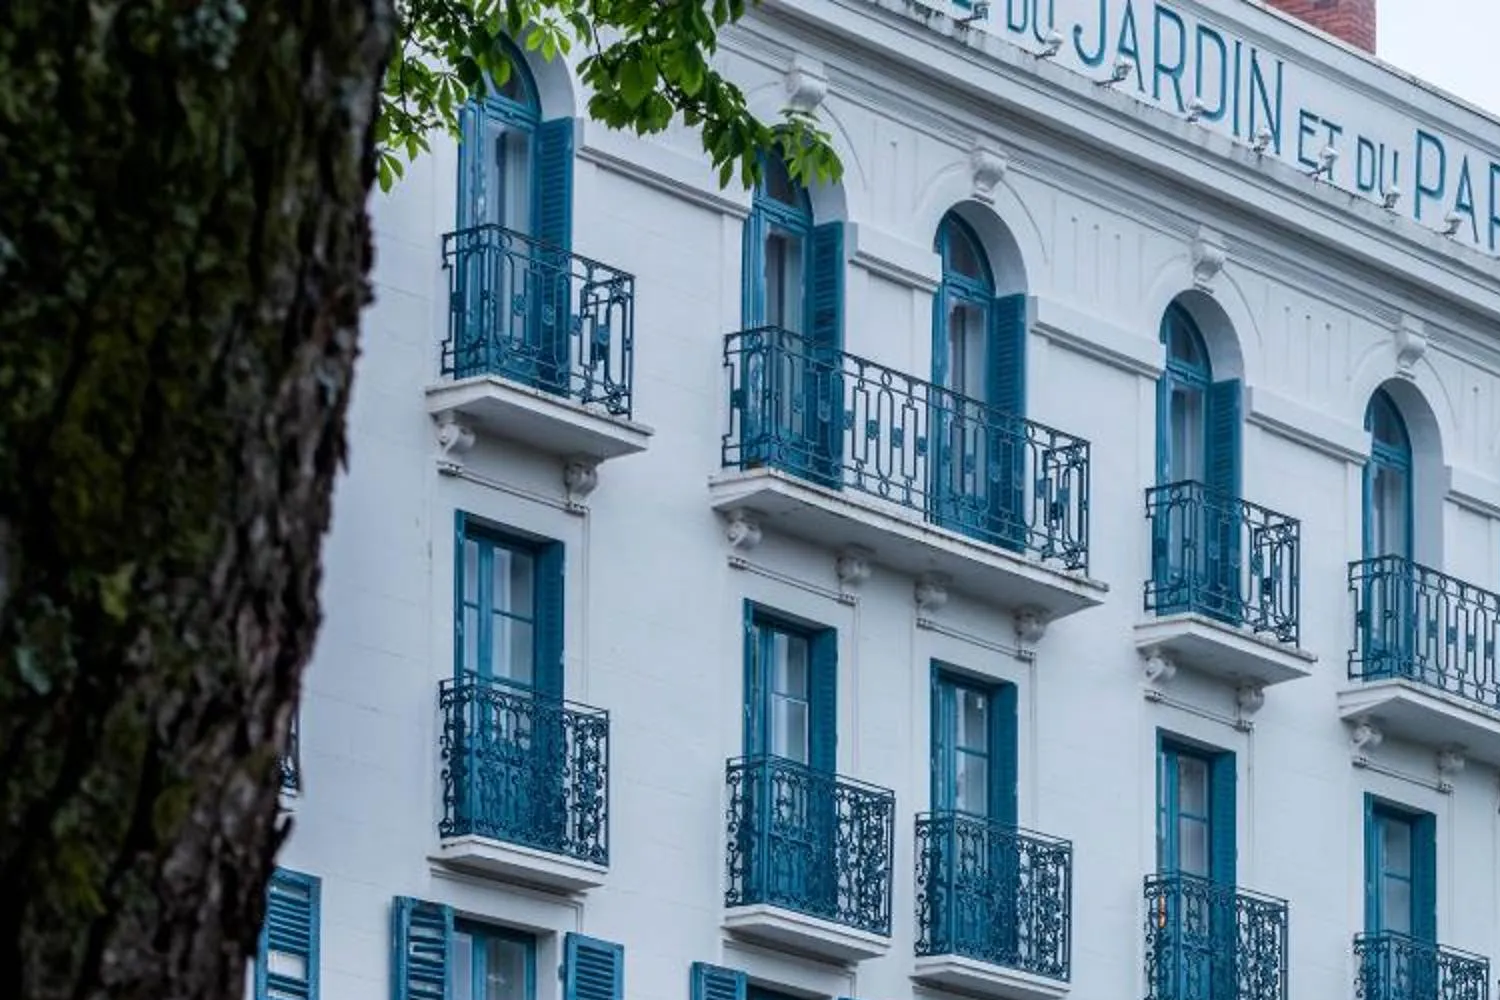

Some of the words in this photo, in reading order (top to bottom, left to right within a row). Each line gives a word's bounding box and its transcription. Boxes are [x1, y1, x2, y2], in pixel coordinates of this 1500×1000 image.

[1072, 0, 1284, 156] JARDIN
[1297, 108, 1343, 180] ET
[1357, 135, 1400, 199] DU
